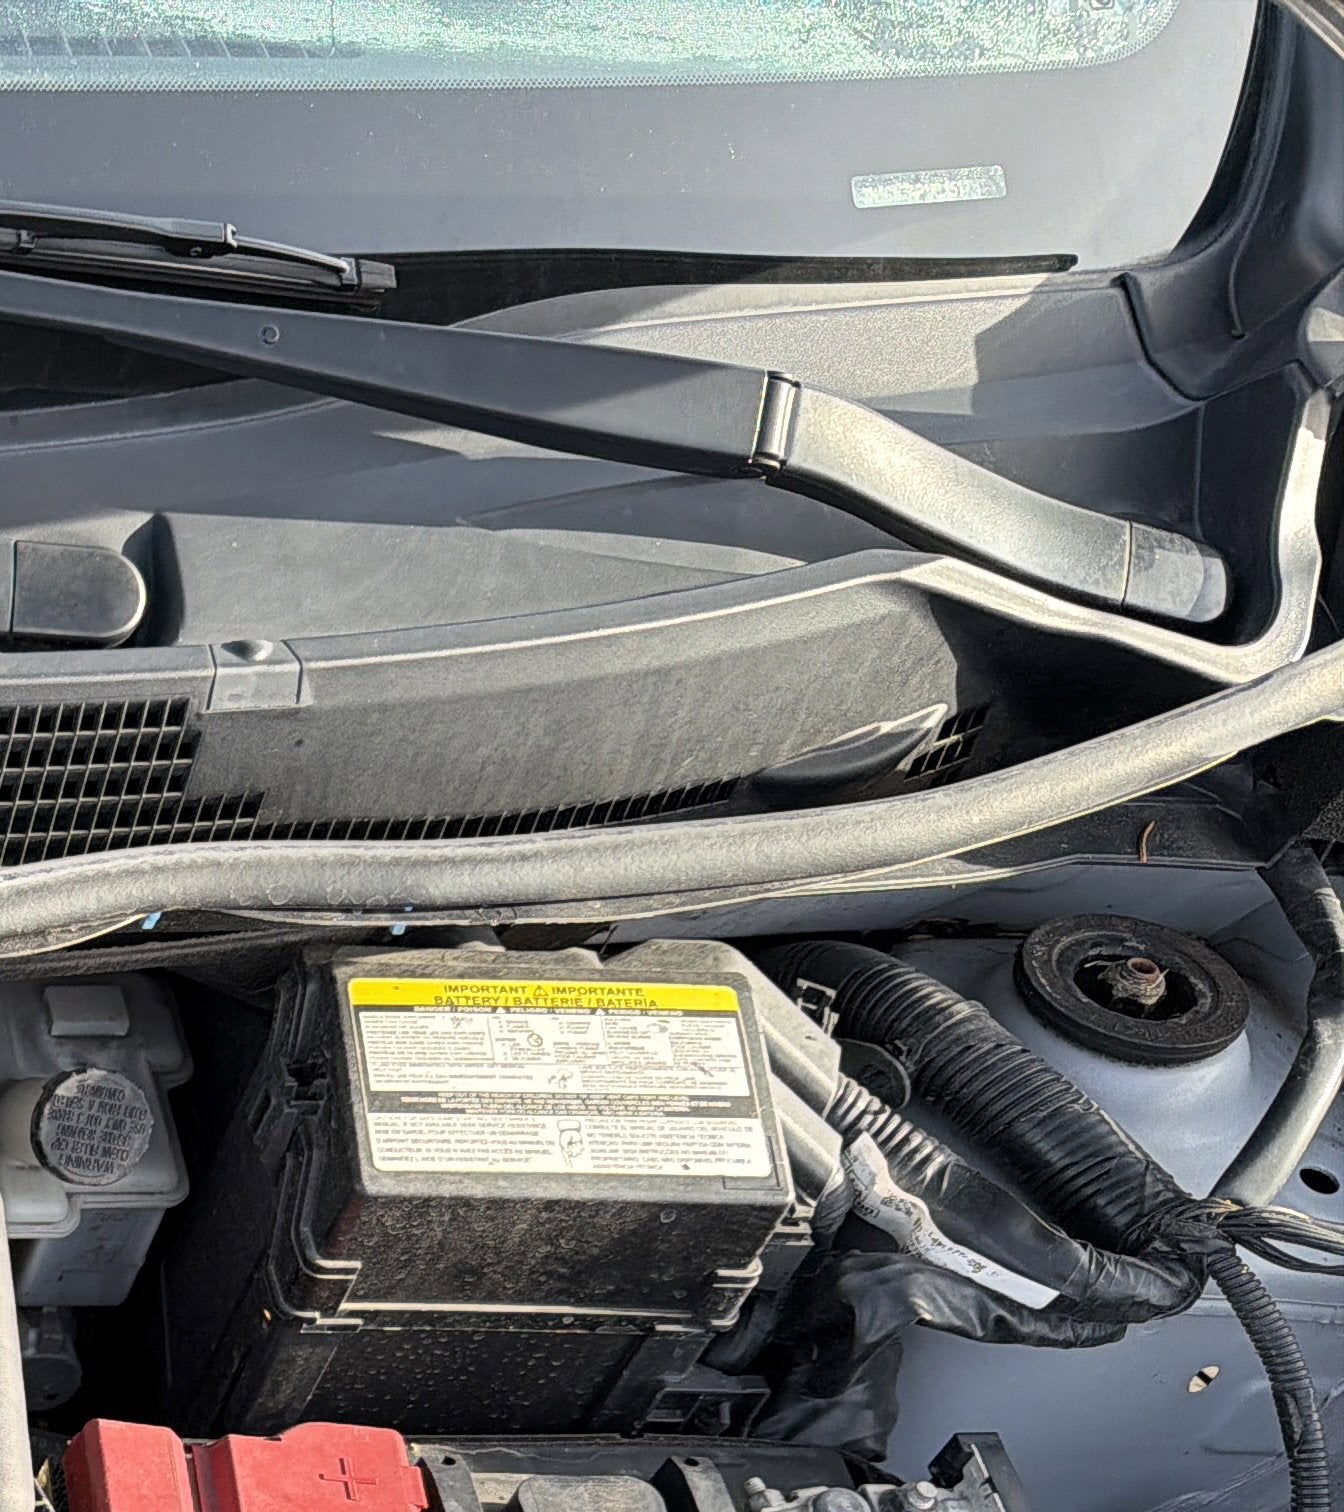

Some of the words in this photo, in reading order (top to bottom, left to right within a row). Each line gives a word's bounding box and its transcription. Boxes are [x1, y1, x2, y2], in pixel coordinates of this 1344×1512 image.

[443, 985, 528, 994] IMPORTANT
[551, 987, 644, 997] IMPORTANTE
[434, 996, 500, 1006] BATTERY
[513, 996, 583, 1007] BATTERIE
[58, 1154, 114, 1173] WARNING
